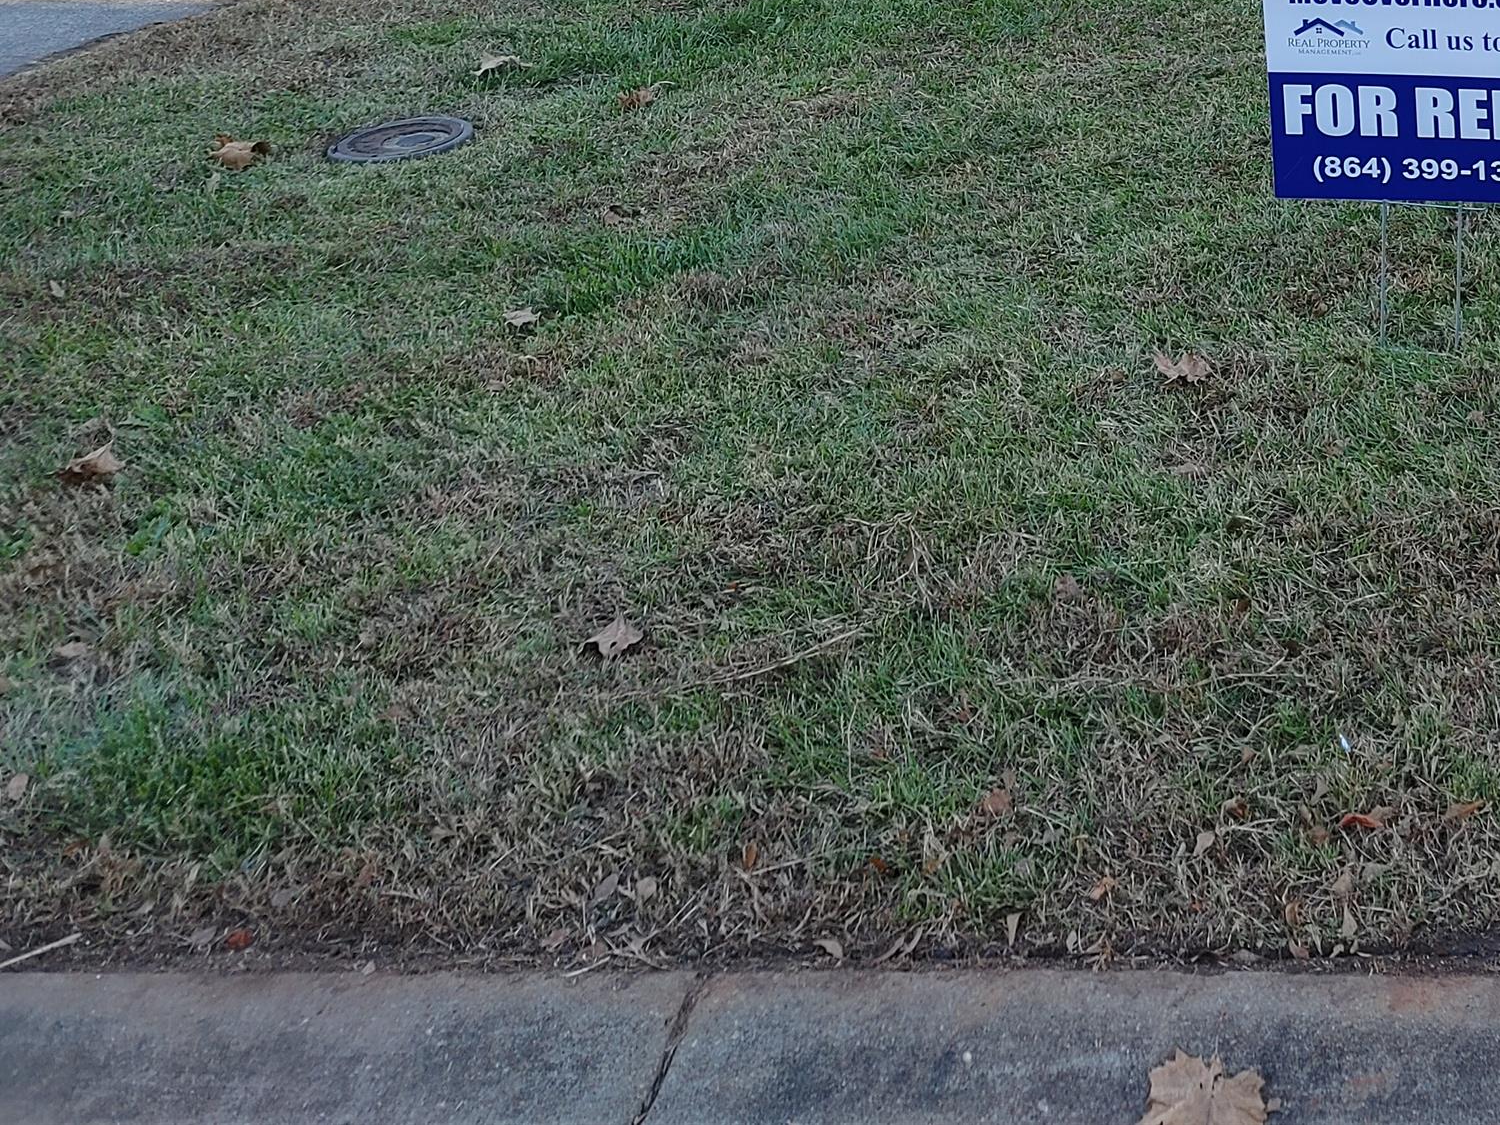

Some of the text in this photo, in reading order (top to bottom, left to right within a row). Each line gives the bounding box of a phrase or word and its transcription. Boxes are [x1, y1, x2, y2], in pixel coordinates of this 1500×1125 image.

[1287, 37, 1371, 49] REAL PROPERTY
[1298, 48, 1353, 56] MANAGEMENT
[1385, 27, 1438, 51] Call
[1447, 33, 1474, 52] us
[1282, 83, 1399, 138] FOR
[1312, 155, 1392, 184] (864)
